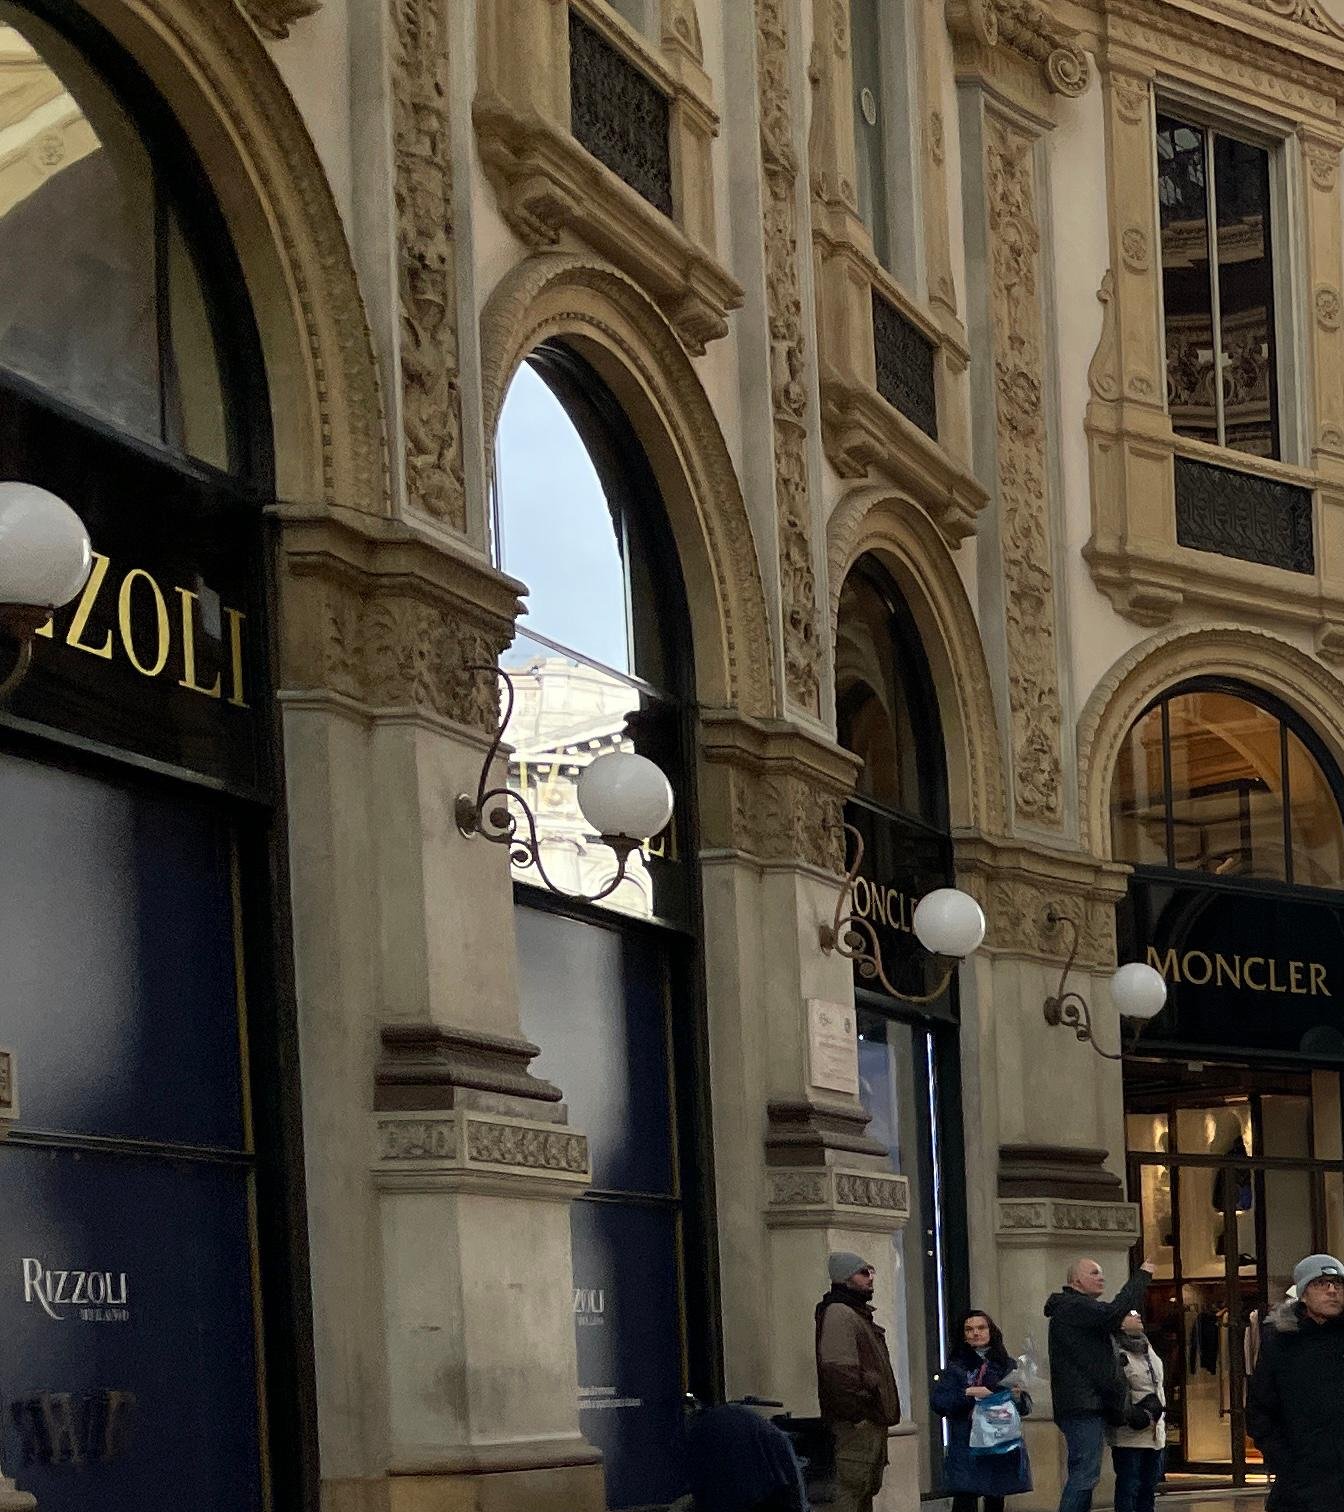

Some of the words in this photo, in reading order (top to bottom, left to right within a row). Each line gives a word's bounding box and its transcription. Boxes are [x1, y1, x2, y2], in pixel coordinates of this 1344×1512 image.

[35, 550, 250, 708] ZOLI
[854, 876, 917, 934] ONCL
[1146, 945, 1332, 997] MONCLER
